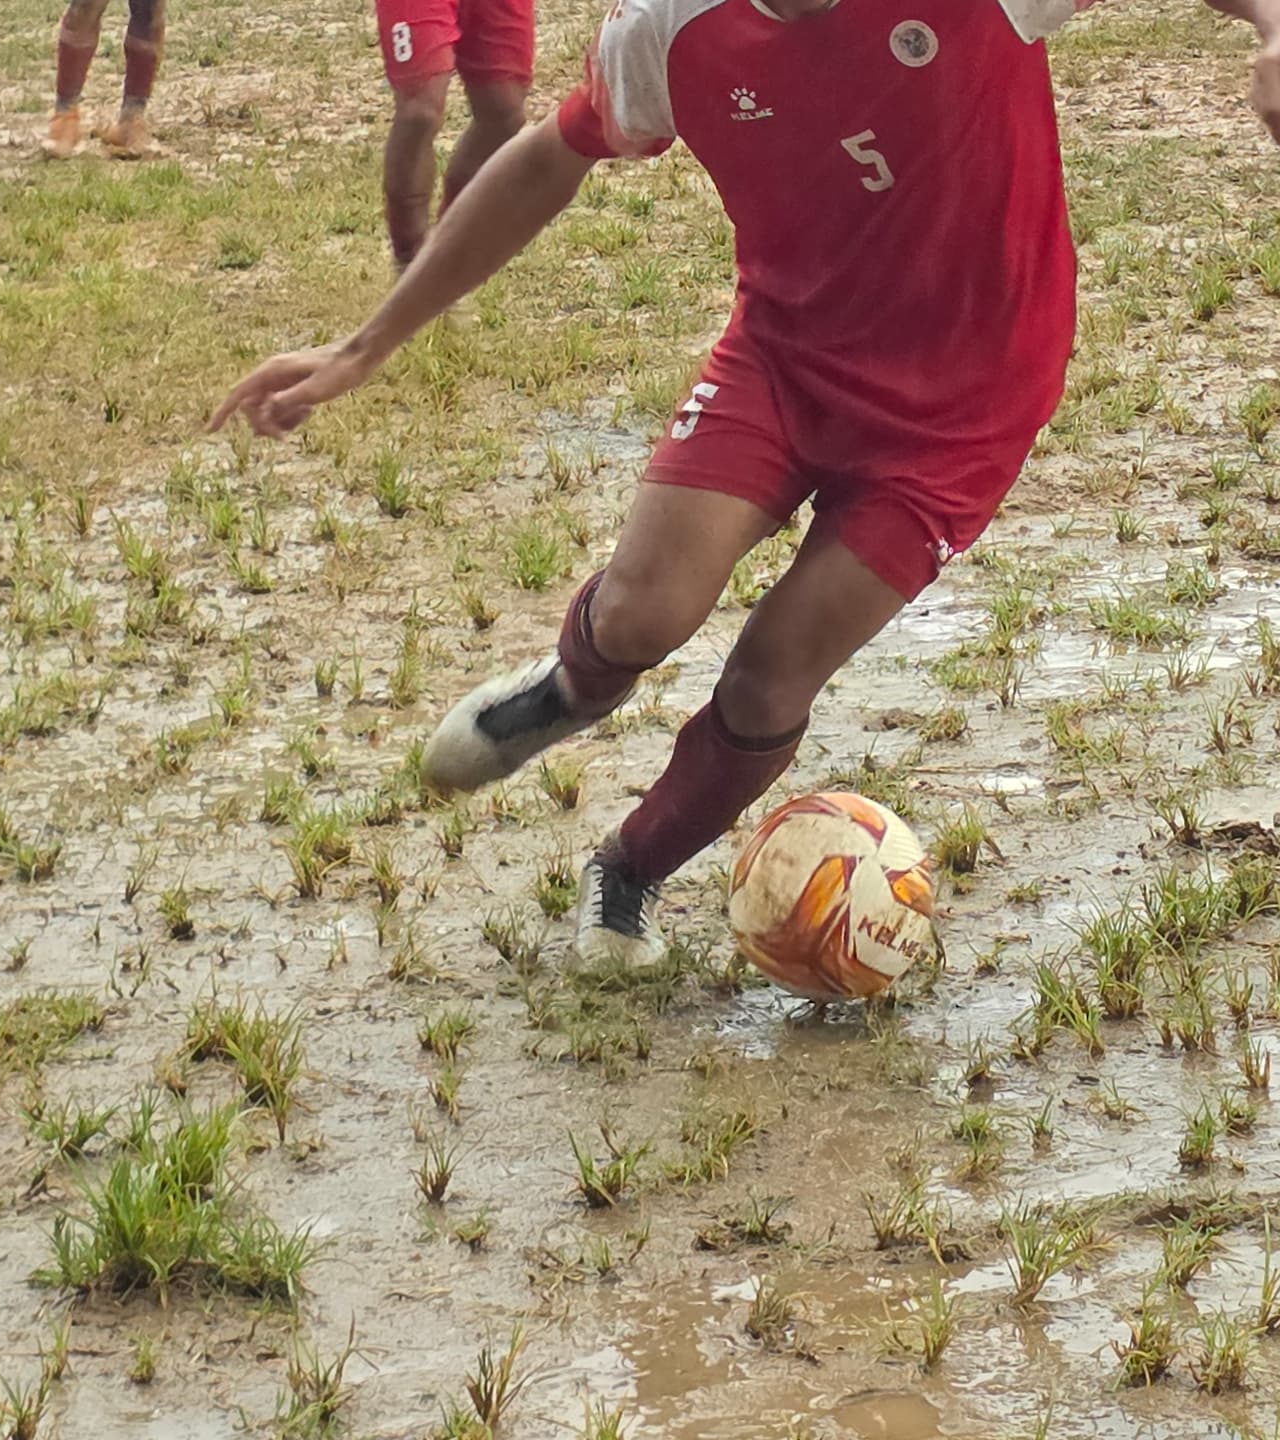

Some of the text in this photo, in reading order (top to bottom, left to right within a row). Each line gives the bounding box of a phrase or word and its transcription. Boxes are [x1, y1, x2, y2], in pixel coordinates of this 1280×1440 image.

[391, 21, 413, 62] 8
[840, 128, 895, 192] 5
[670, 382, 721, 440] 5
